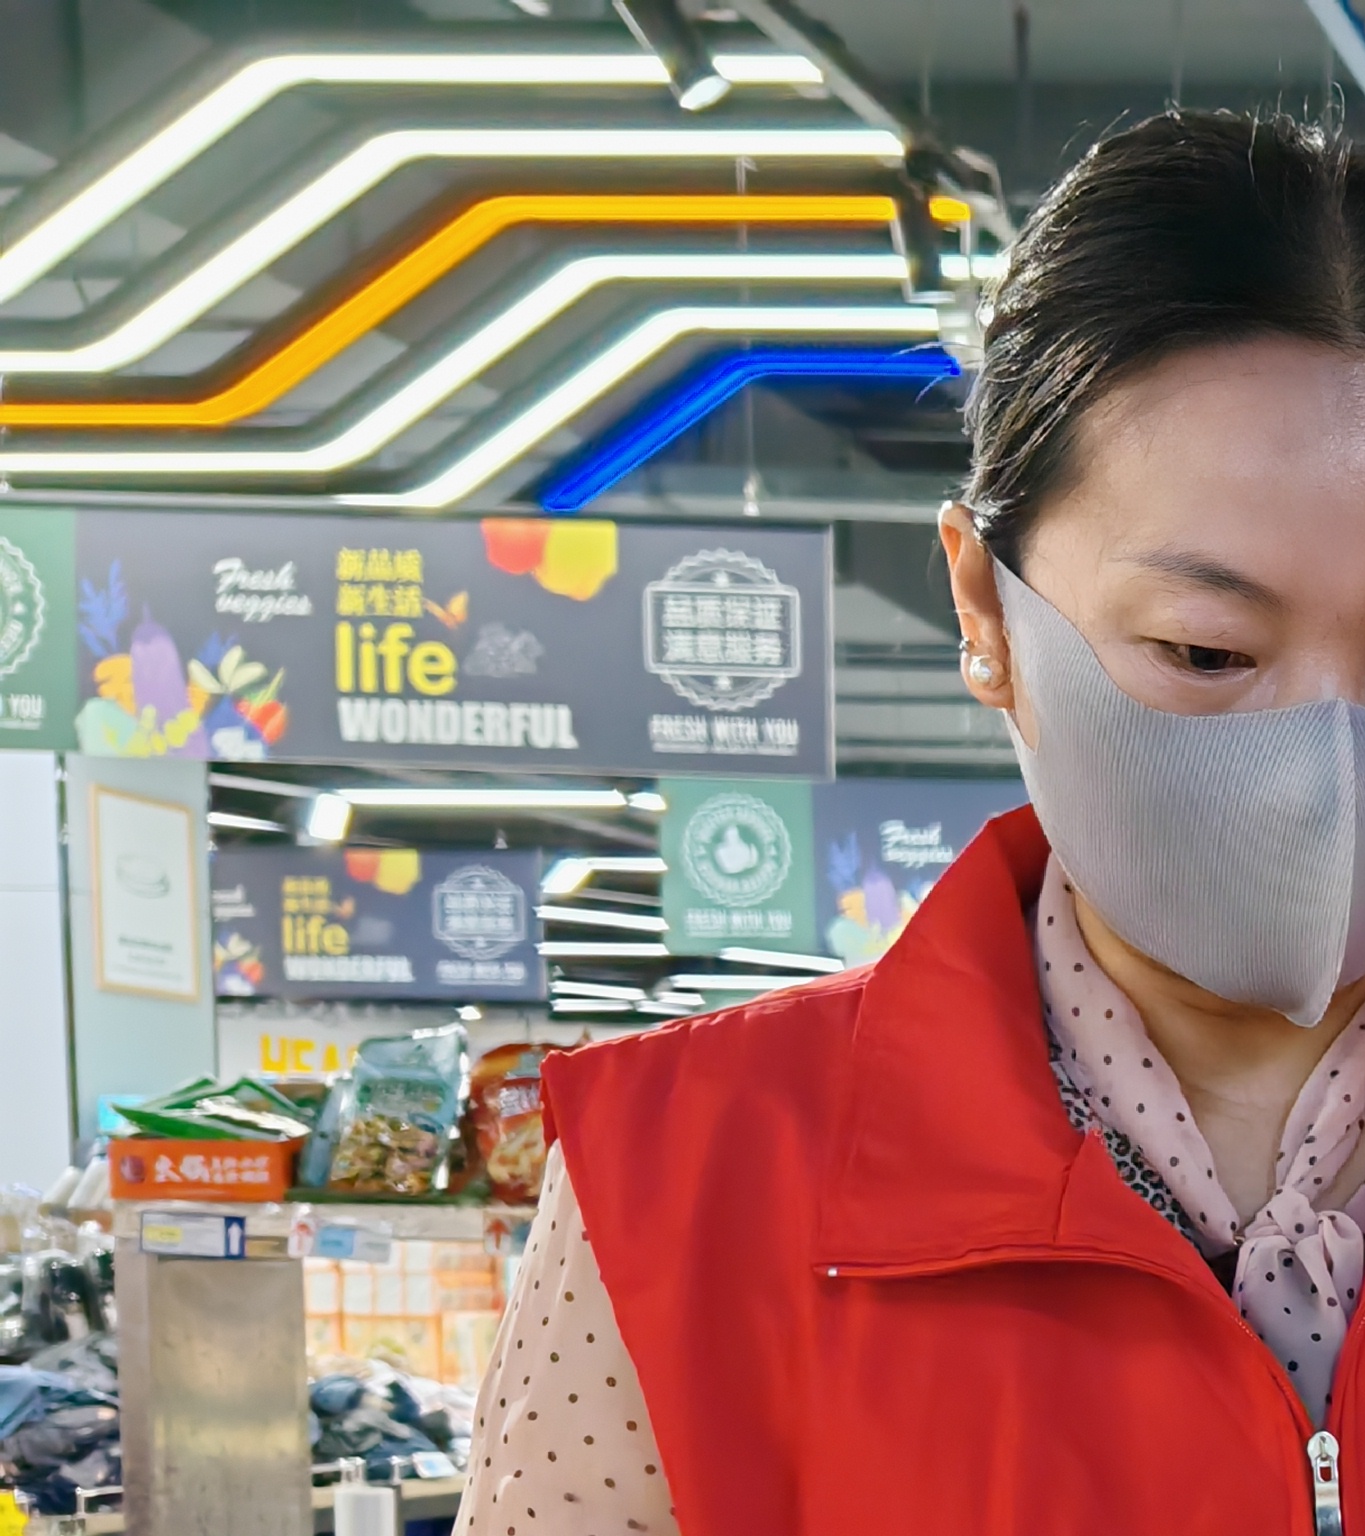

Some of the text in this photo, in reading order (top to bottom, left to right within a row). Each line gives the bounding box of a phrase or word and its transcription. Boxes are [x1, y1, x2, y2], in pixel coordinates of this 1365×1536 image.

[335, 620, 458, 696] life
[337, 697, 579, 749] WONDERFUL
[282, 914, 350, 955] life
